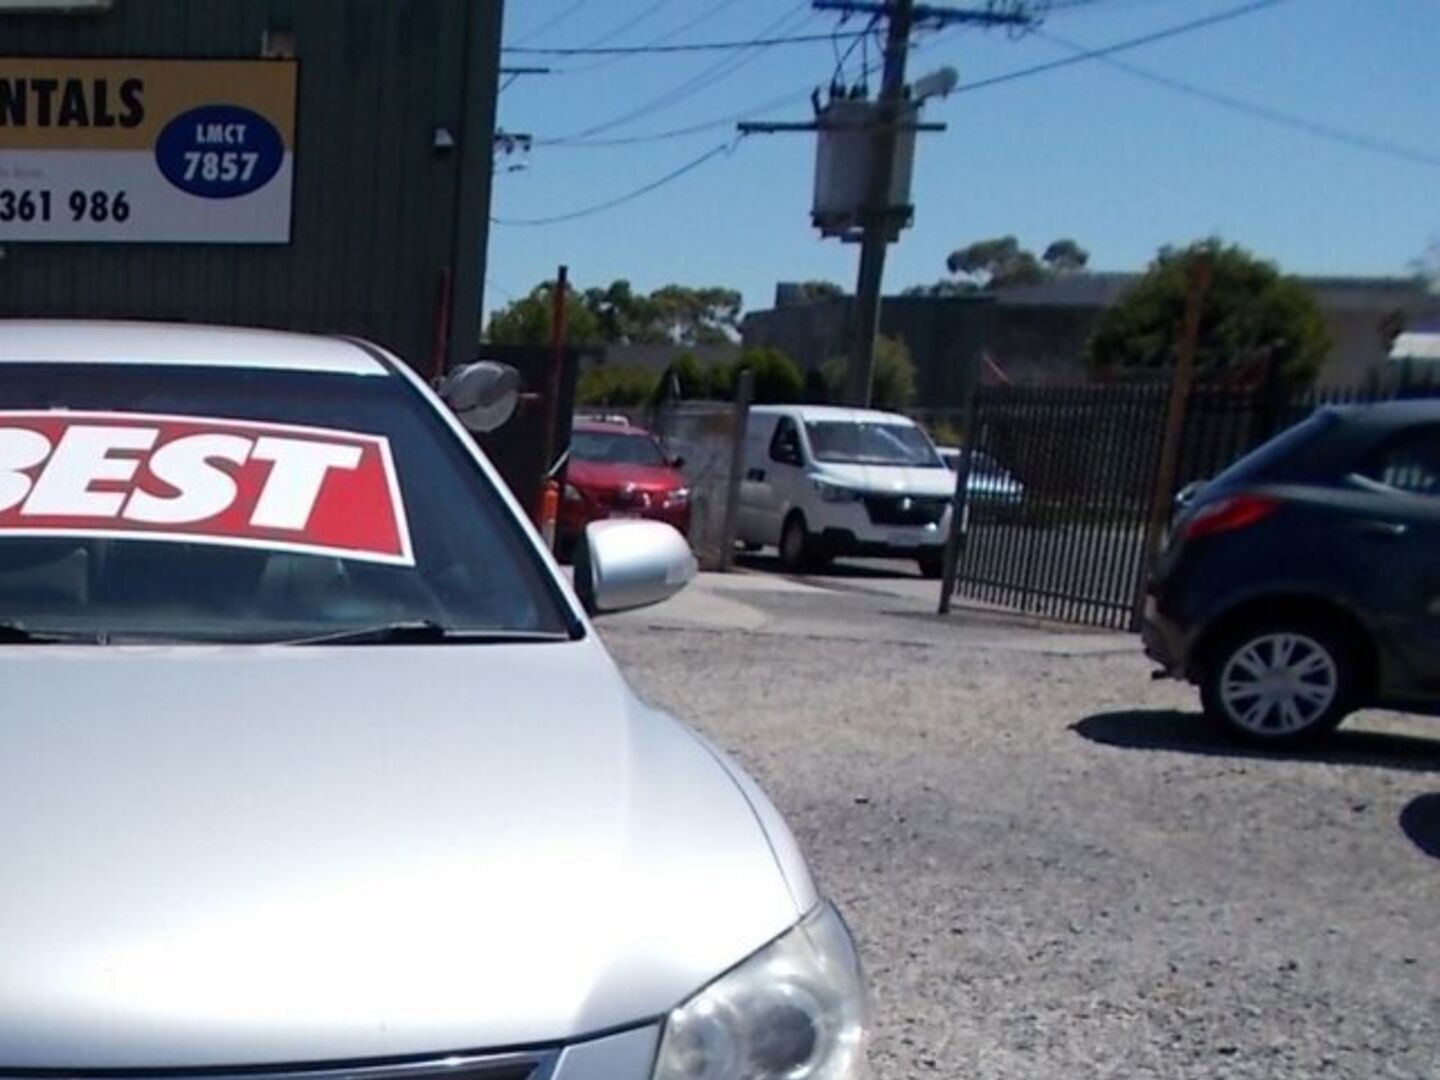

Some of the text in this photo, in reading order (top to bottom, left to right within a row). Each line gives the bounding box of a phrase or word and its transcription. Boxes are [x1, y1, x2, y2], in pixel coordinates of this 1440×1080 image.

[196, 124, 246, 145] LMCT
[183, 153, 258, 181] 7857
[69, 191, 130, 222] 986
